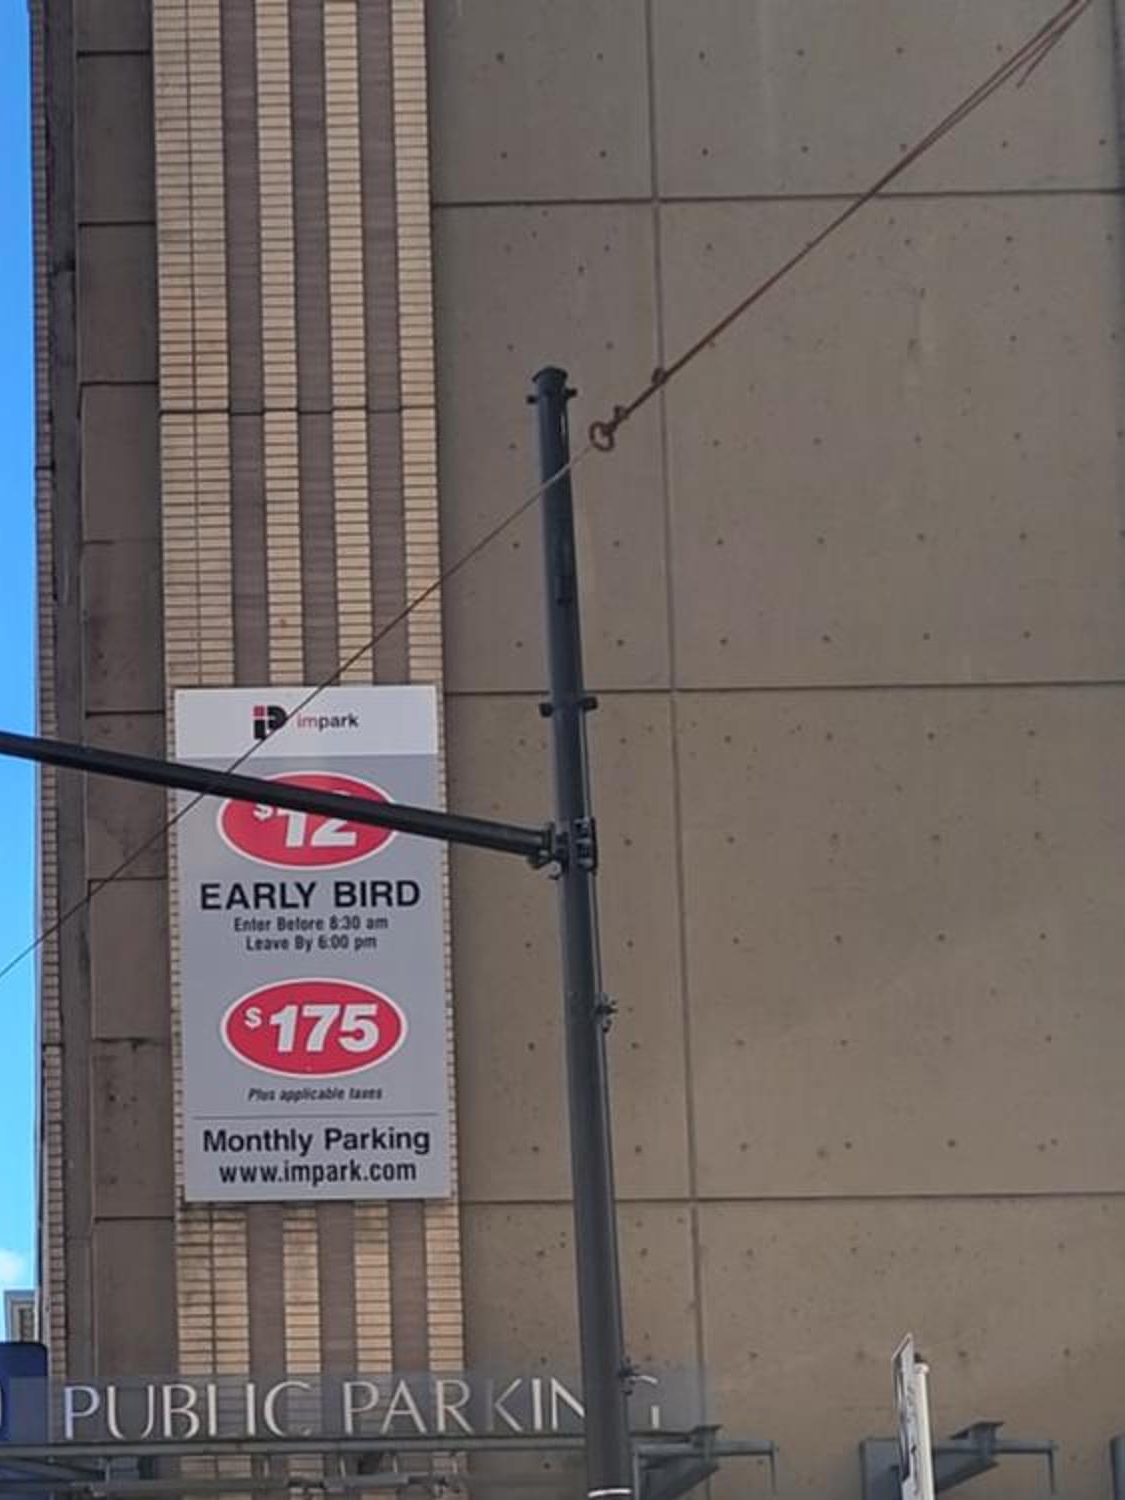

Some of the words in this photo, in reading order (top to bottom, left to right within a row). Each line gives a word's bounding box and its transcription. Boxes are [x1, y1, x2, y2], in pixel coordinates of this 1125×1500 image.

[297, 712, 359, 731] impark
[200, 882, 316, 910] EARLY
[334, 880, 421, 908] BIRD
[234, 917, 272, 932] Enter
[277, 916, 324, 931] Before
[329, 915, 360, 930] 8:30
[366, 918, 389, 929] am
[246, 936, 289, 950] Leave
[294, 935, 312, 952] By
[317, 934, 349, 950] 6:00
[354, 936, 378, 951] pm
[244, 1003, 380, 1053] $175
[248, 1088, 275, 1101] Plus
[279, 1087, 345, 1103] applicable
[349, 1088, 383, 1100] taxes
[203, 1129, 313, 1157] Monthly
[324, 1127, 431, 1155] Parking
[219, 1159, 417, 1187] www.impark.com
[64, 1380, 312, 1440] PUBLIC
